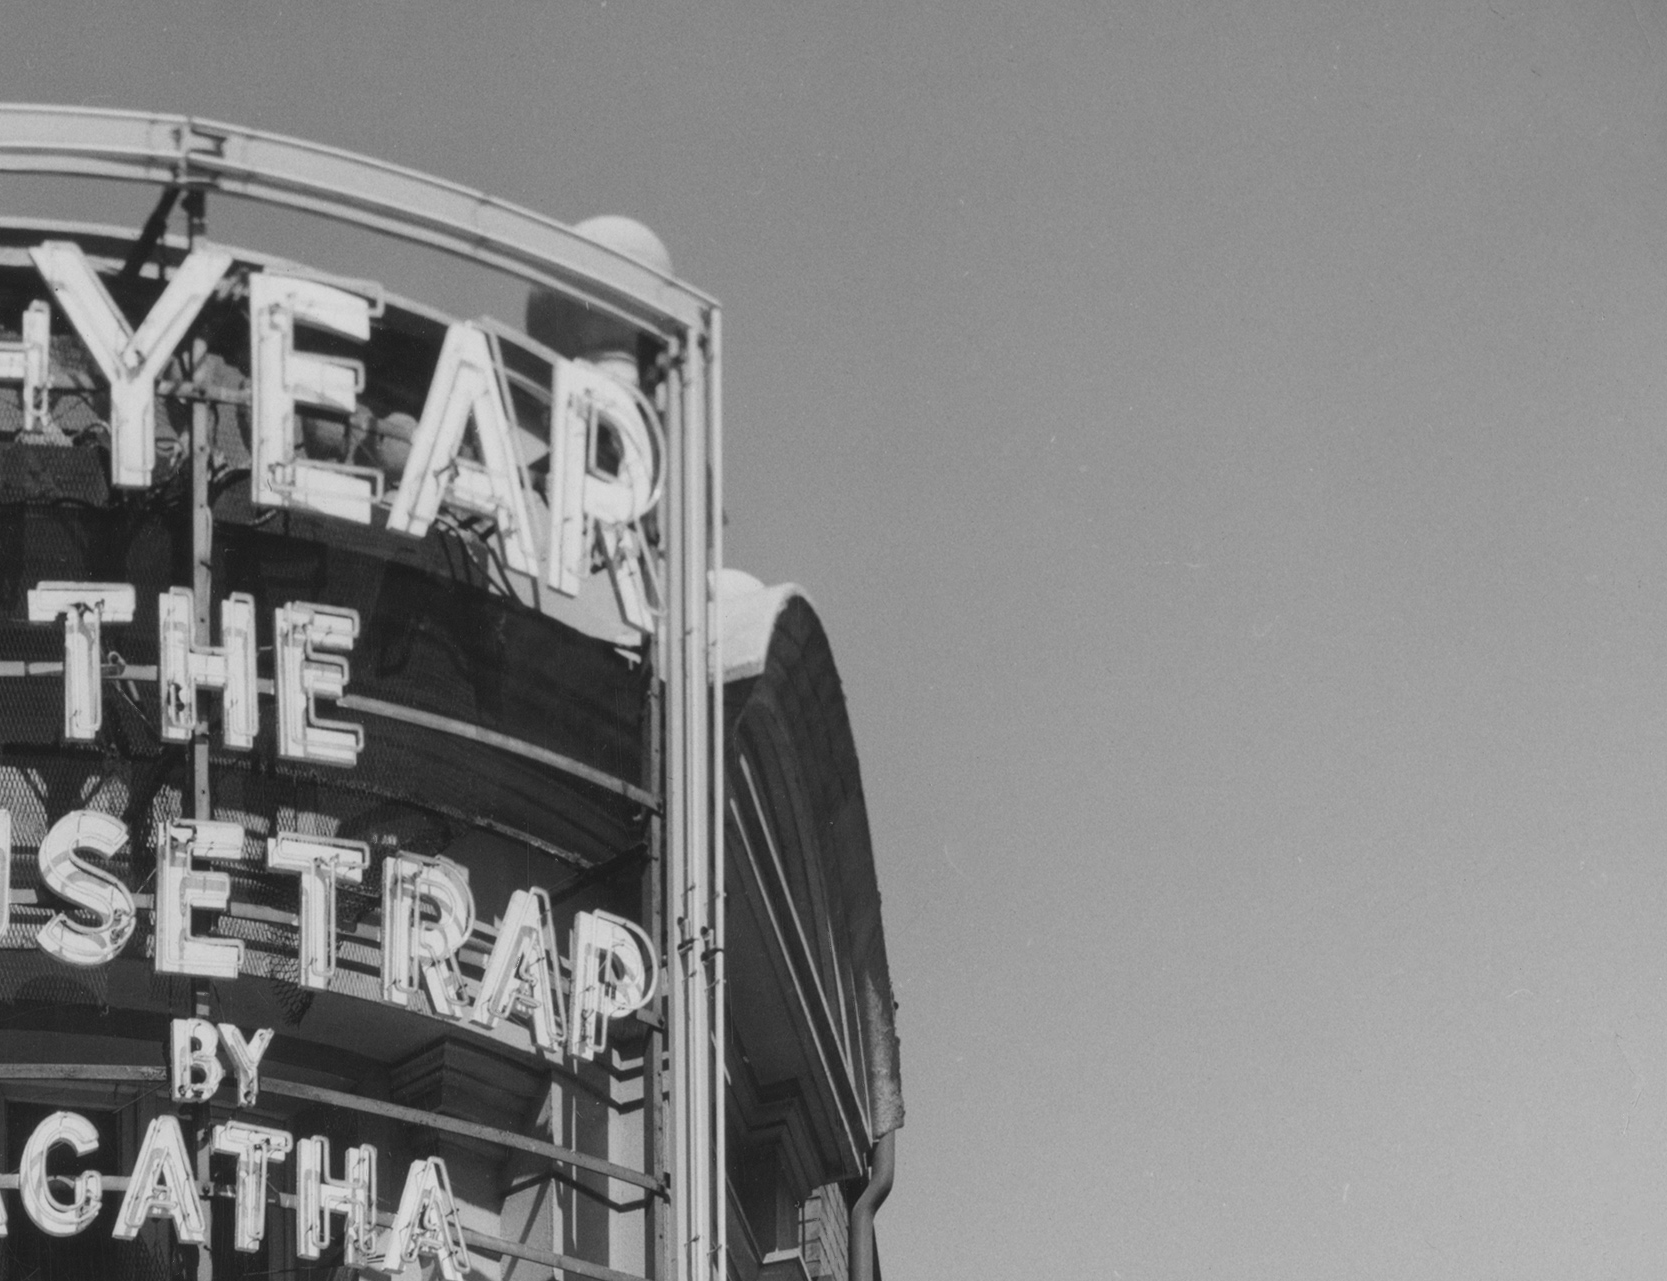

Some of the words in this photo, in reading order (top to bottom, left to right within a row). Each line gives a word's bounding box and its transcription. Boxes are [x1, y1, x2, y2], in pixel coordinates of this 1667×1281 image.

[27, 238, 667, 634] YEAR
[27, 580, 365, 768] THE
[170, 1017, 274, 1105] BY
